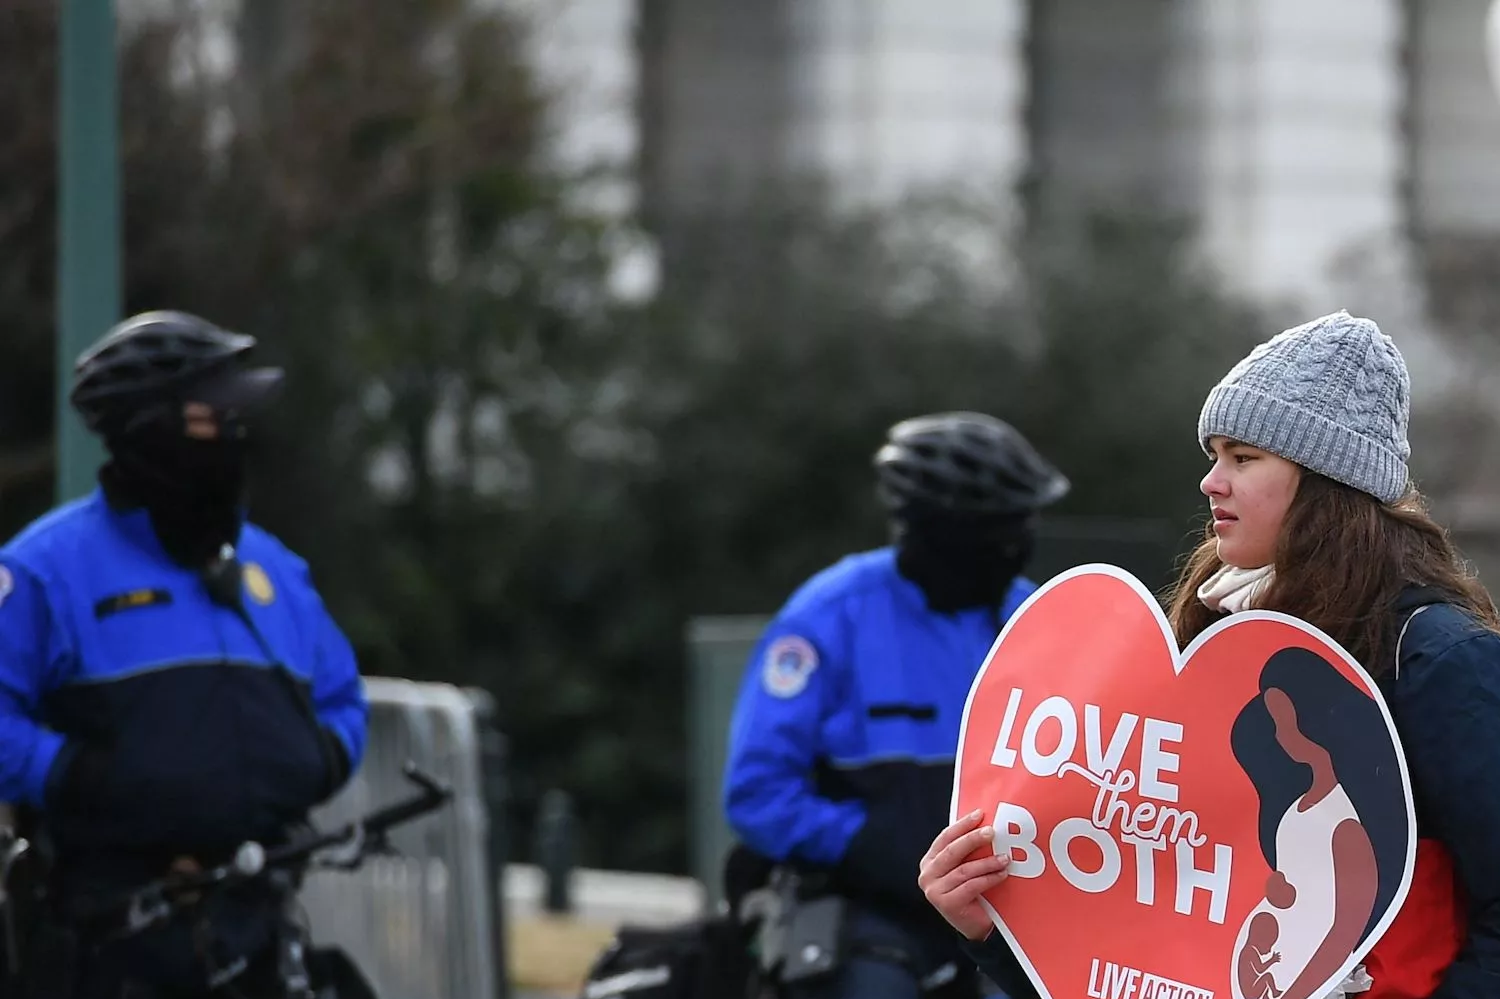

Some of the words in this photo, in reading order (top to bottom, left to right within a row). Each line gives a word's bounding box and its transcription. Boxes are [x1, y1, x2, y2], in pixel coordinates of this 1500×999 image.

[990, 687, 1184, 803] LOVE
[992, 801, 1233, 925] BOTH
[1057, 762, 1208, 848] them
